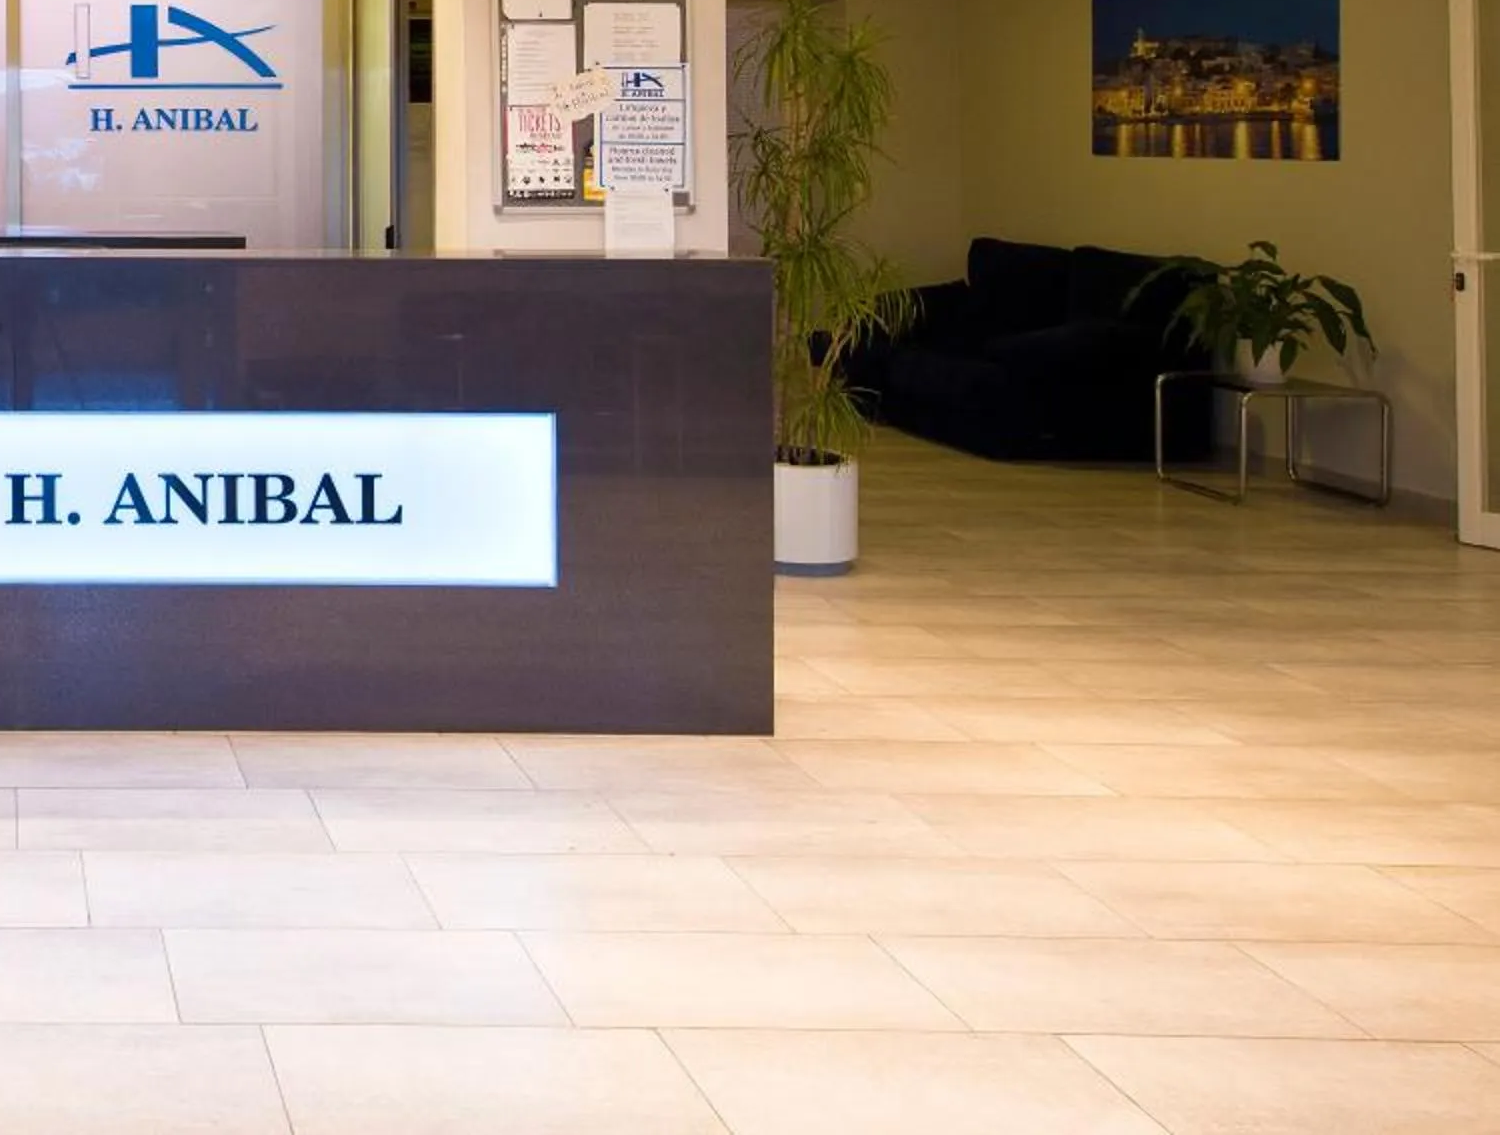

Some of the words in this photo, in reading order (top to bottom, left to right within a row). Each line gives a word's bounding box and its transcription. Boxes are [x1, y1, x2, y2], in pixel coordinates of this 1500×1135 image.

[90, 108, 123, 132] H.
[131, 107, 259, 132] ANIBAL
[3, 472, 82, 526] H.
[102, 471, 403, 526] ANIBAL
